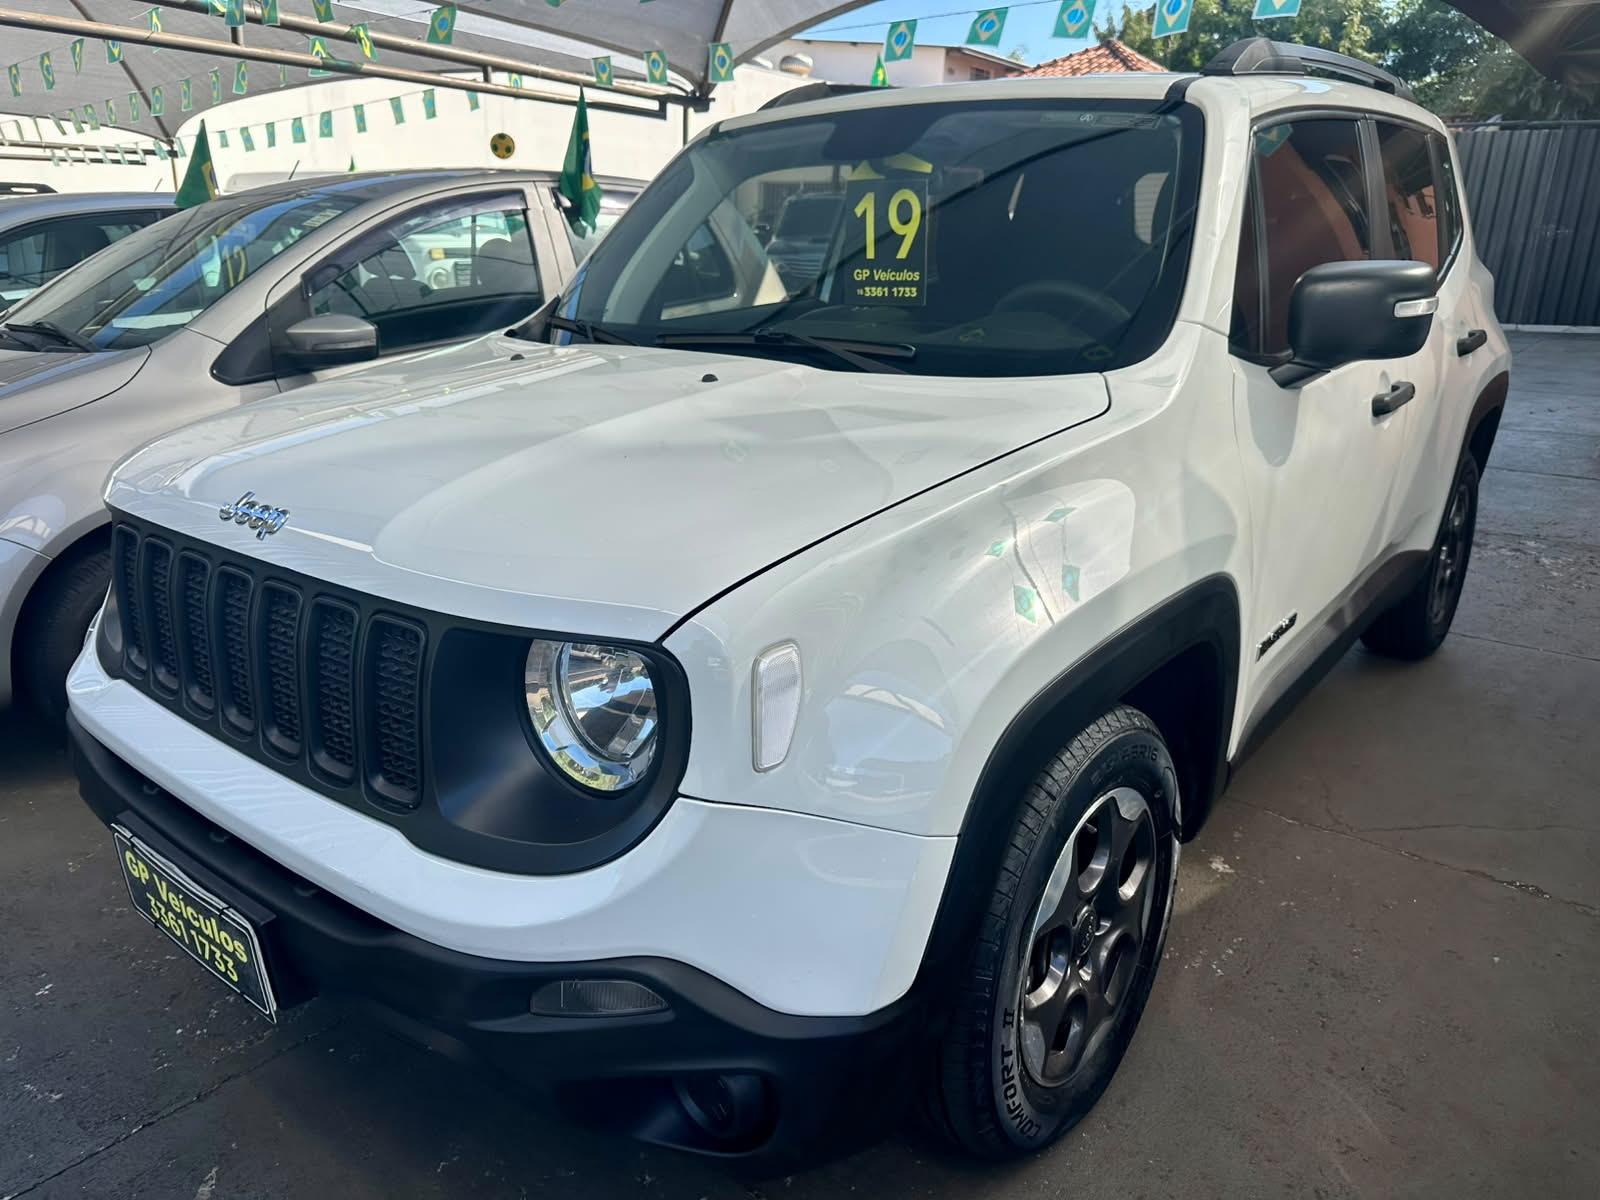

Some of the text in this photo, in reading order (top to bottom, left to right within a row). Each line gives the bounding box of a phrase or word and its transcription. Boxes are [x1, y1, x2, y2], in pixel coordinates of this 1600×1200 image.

[854, 188, 922, 260] 19
[853, 268, 921, 282] GP Veículos
[864, 286, 889, 297] 3361
[891, 286, 918, 298] 1733
[219, 490, 291, 541] Jeep
[124, 850, 150, 885] GP
[146, 892, 239, 983] 3361 1733
[1000, 1043, 1041, 1138] COMFORT
